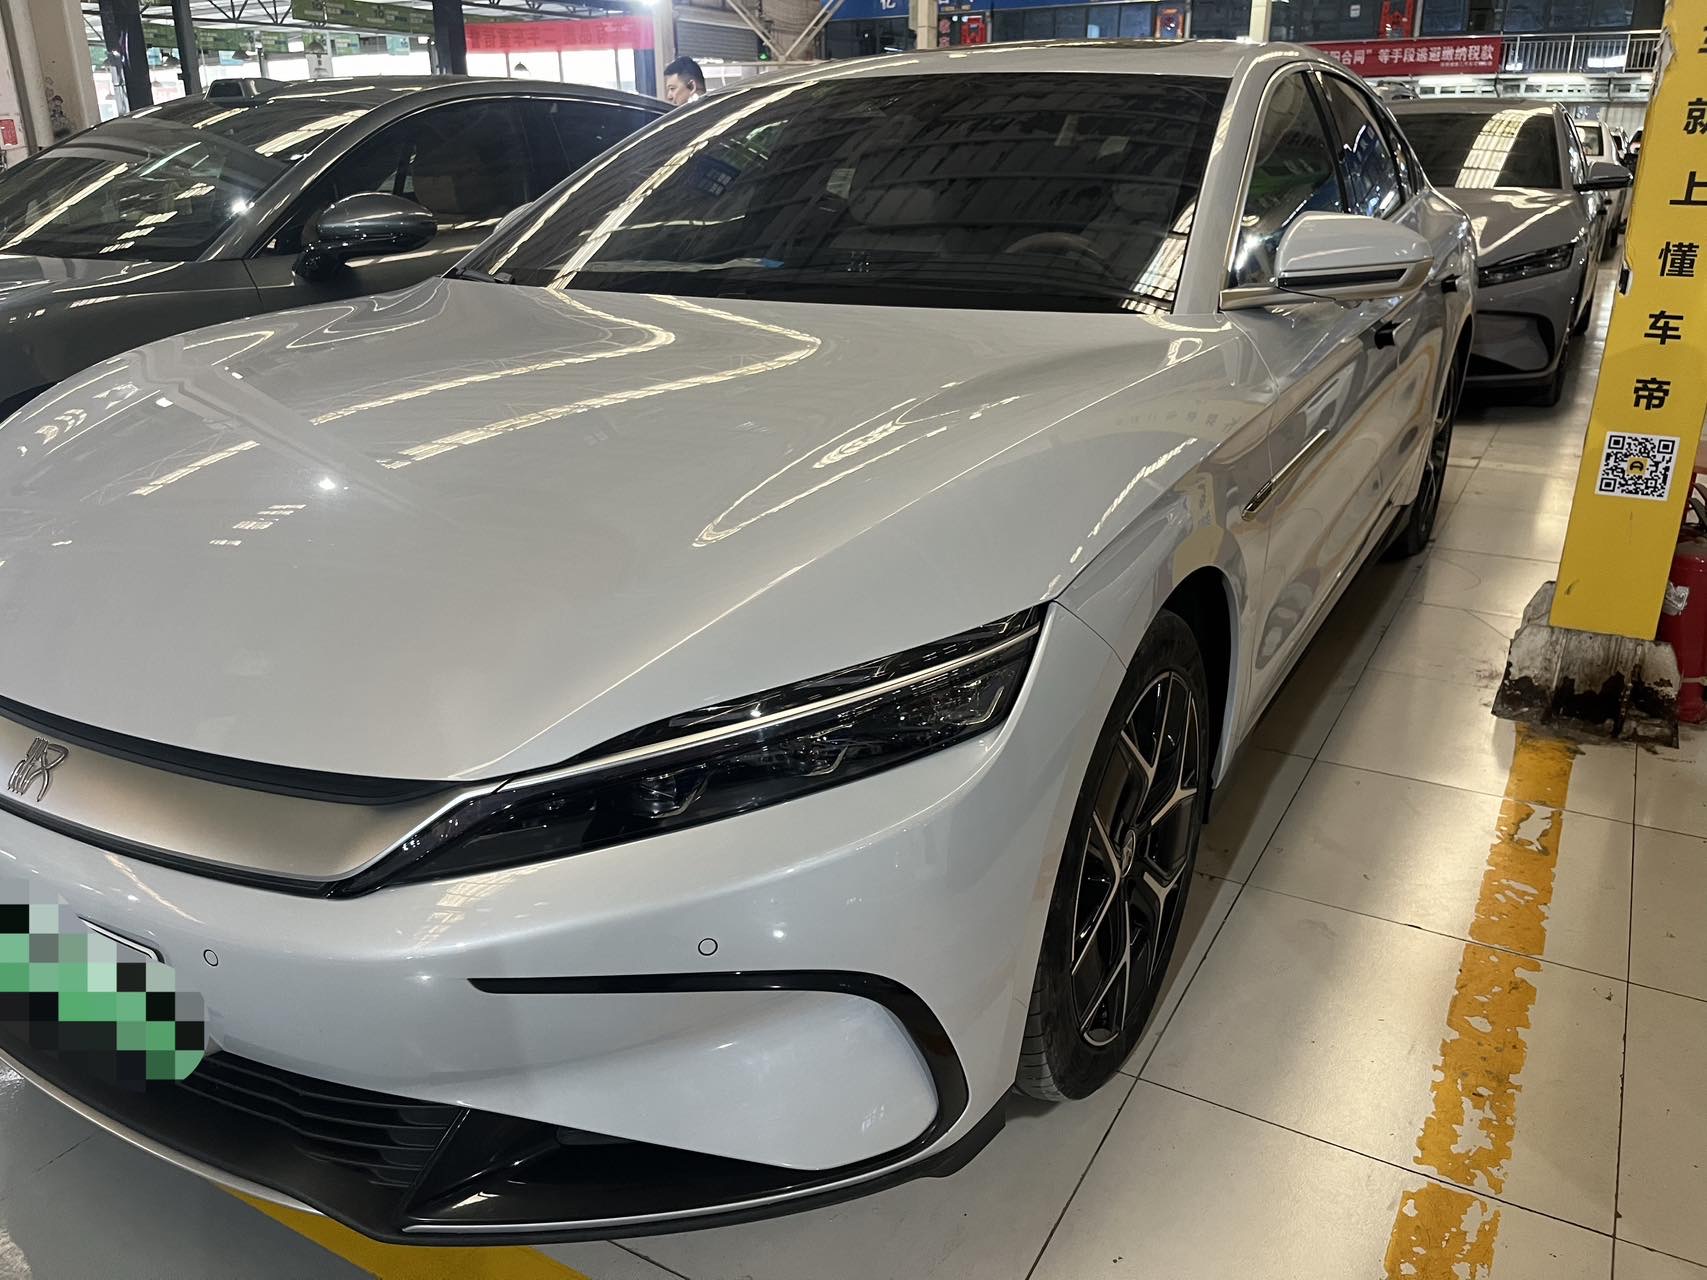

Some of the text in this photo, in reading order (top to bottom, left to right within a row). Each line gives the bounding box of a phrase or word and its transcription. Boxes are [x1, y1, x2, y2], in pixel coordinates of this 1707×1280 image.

[1633, 26, 1707, 411] 就上懂车帝
